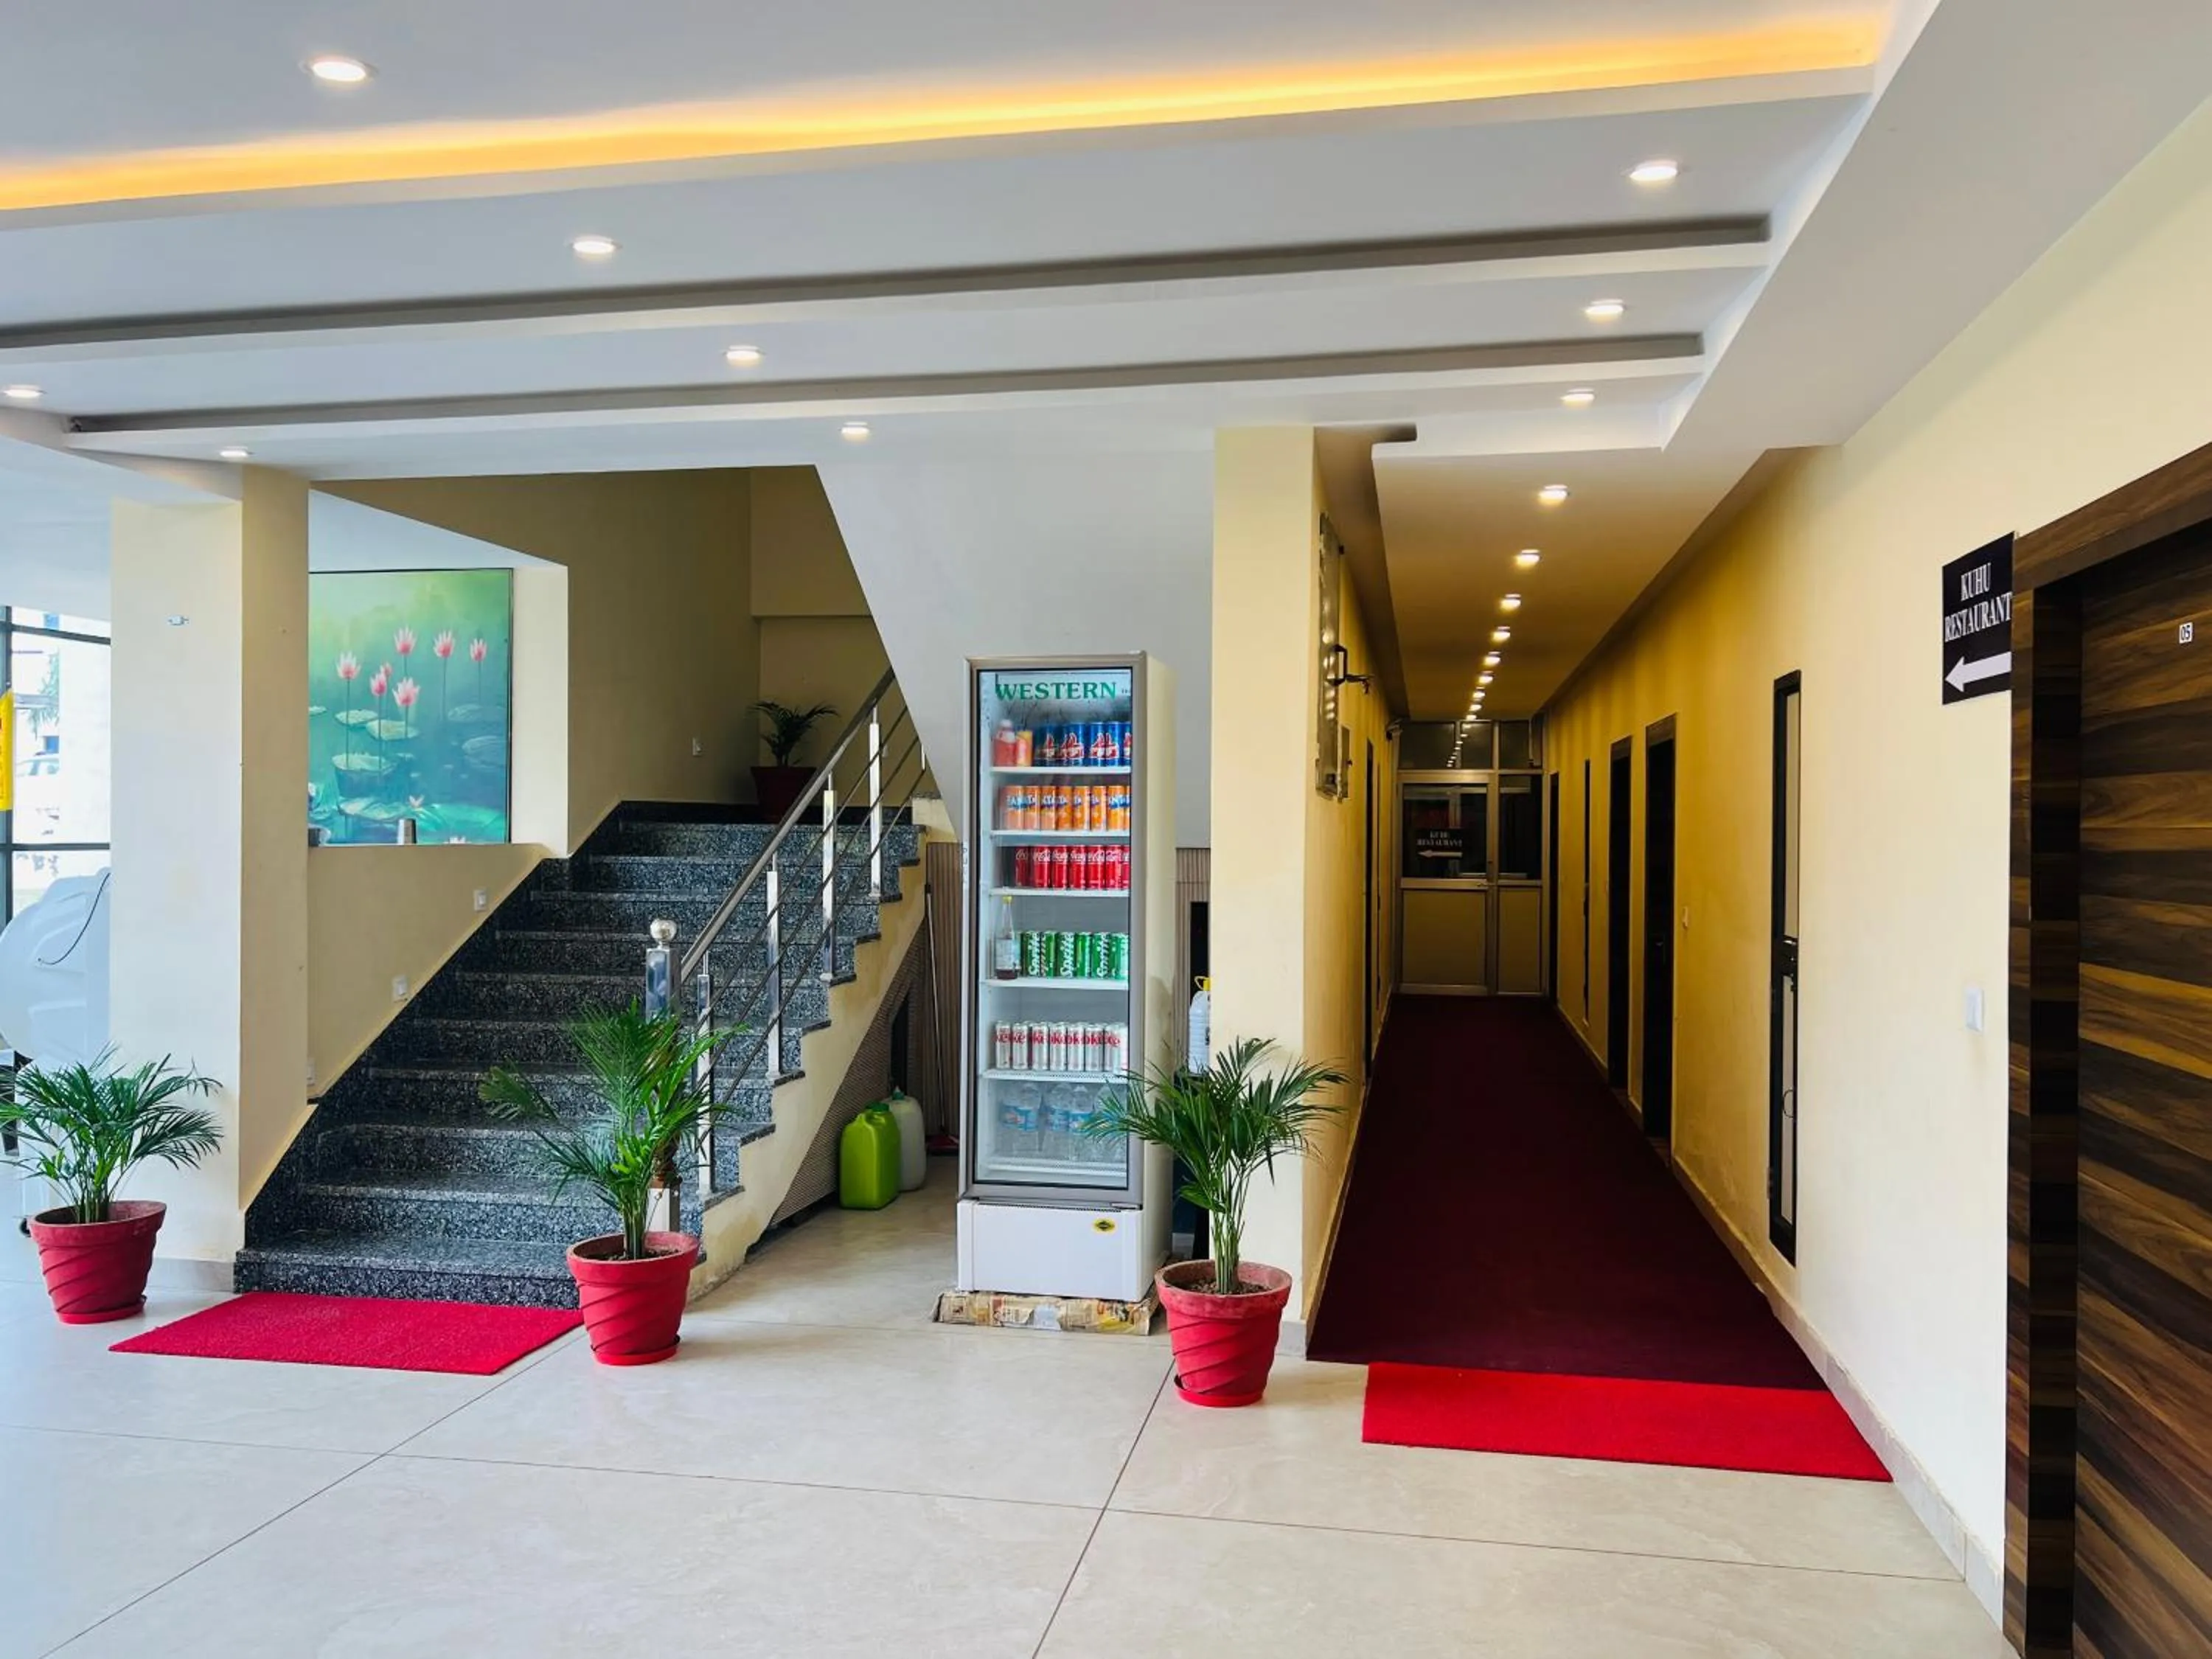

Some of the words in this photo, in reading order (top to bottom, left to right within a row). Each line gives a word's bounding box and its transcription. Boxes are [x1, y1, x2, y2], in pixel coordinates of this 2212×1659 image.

[1961, 562, 1992, 602] KUHU
[1944, 591, 2012, 642] RESTAURANT
[2180, 625, 2191, 641] 05
[995, 681, 1117, 700] WESTERN
